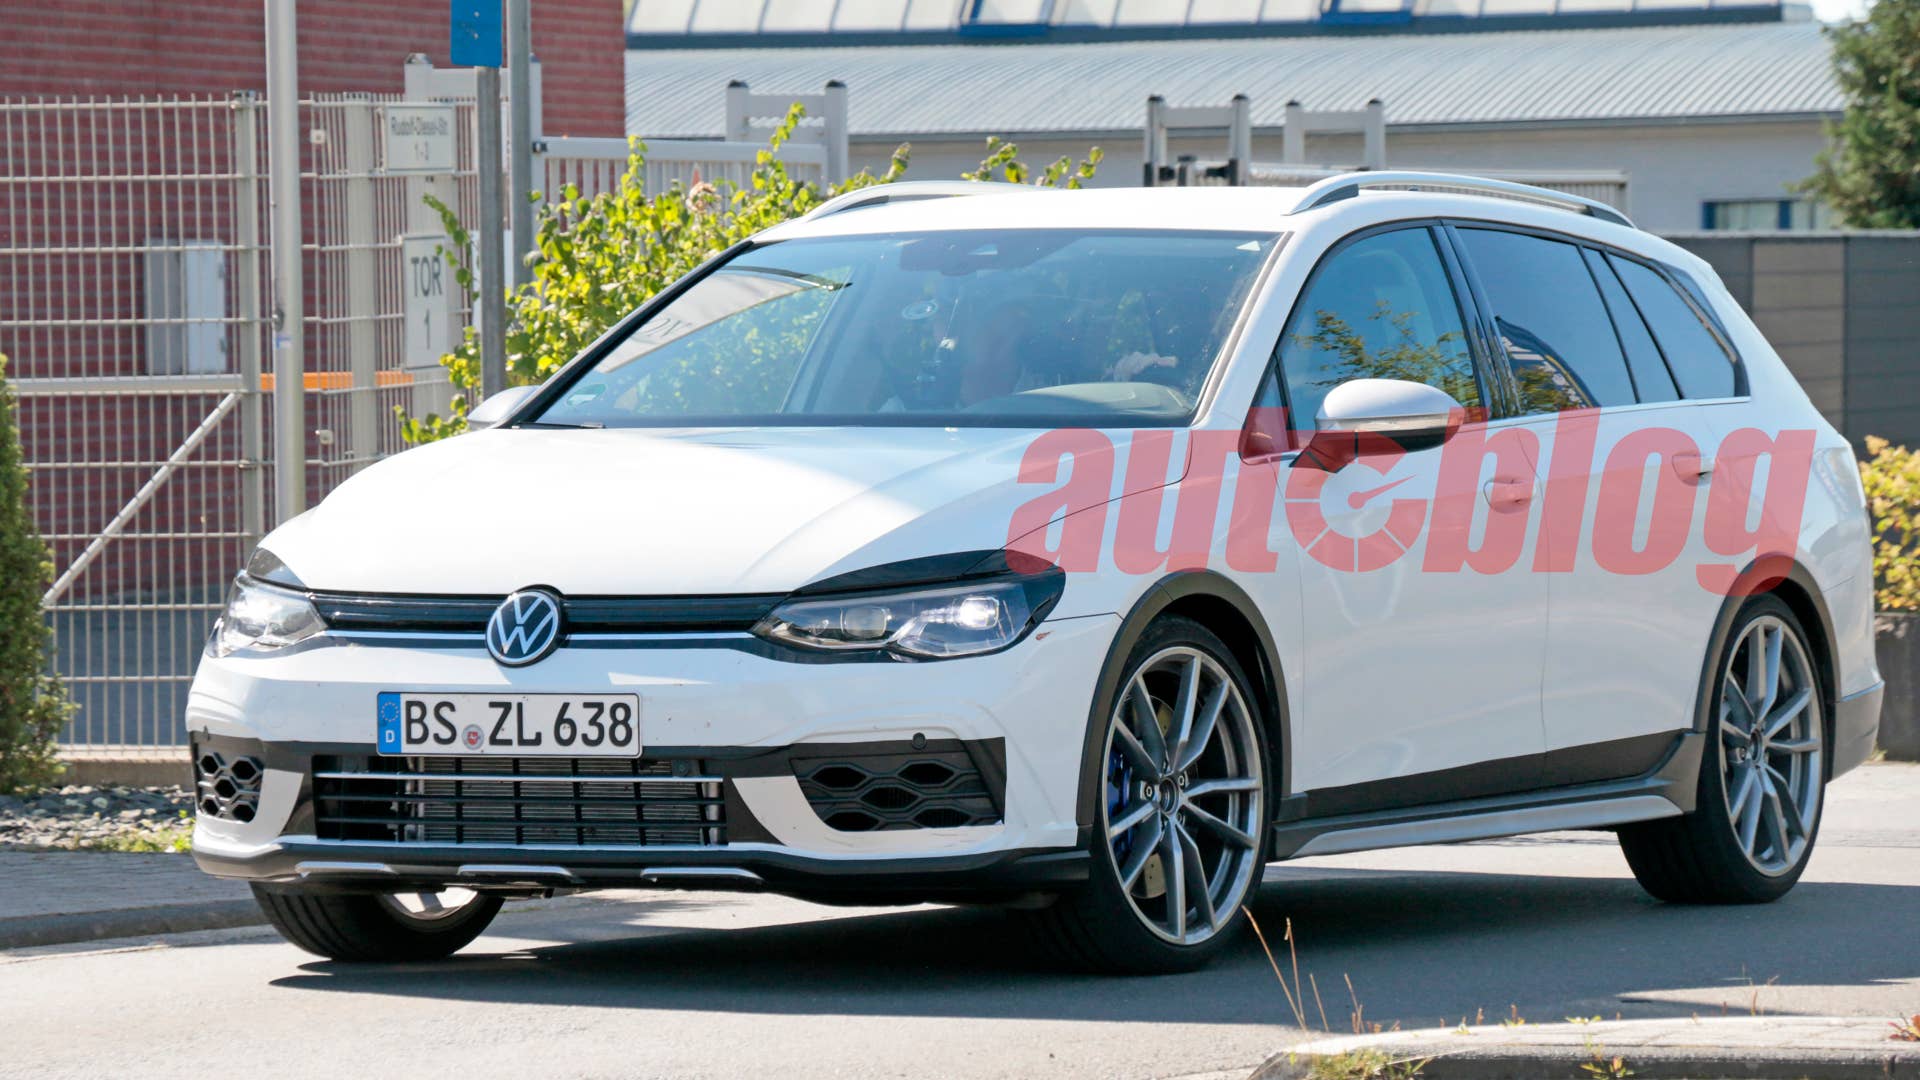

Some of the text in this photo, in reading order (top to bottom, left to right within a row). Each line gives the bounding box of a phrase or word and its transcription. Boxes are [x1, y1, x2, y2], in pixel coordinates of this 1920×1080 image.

[410, 255, 442, 297] TOR
[423, 308, 431, 351] 1
[490, 593, 559, 660] VW
[385, 730, 396, 743] D
[405, 700, 632, 747] BS ZL 638
